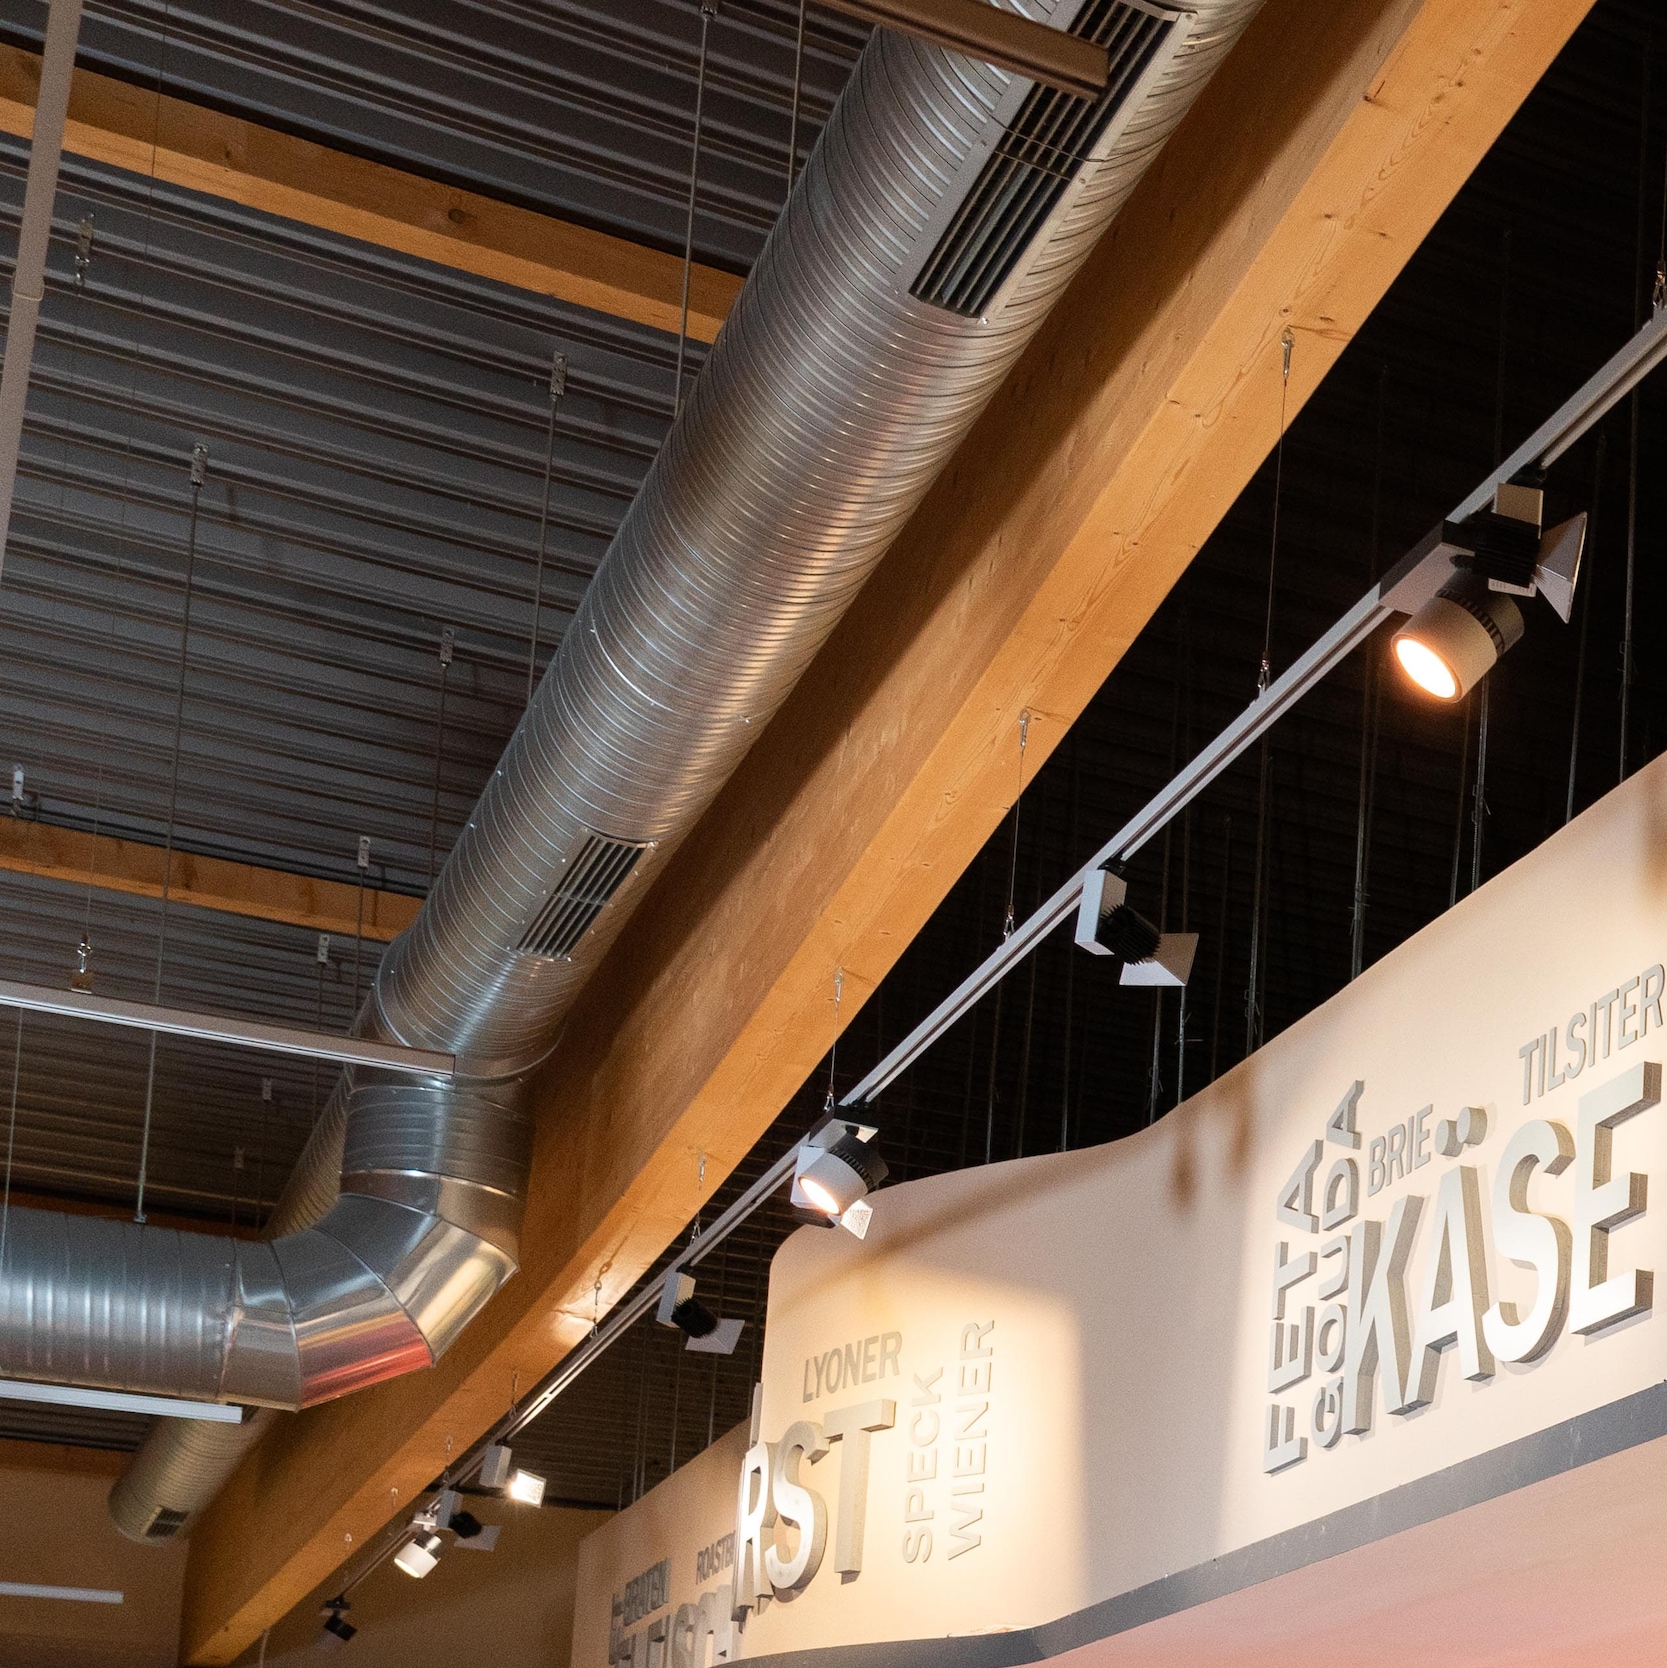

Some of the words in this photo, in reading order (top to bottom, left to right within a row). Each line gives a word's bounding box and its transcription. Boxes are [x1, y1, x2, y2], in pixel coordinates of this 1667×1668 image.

[1519, 963, 1665, 1105] TILSITER
[1341, 1060, 1662, 1436] KÄSE
[1367, 1103, 1433, 1197] BRIE
[802, 1331, 903, 1403] LYONER
[1263, 1139, 1324, 1476] FETA
[1311, 1079, 1365, 1448] GOUDA
[902, 1366, 943, 1564] SPECK
[947, 1319, 995, 1560] WIENER
